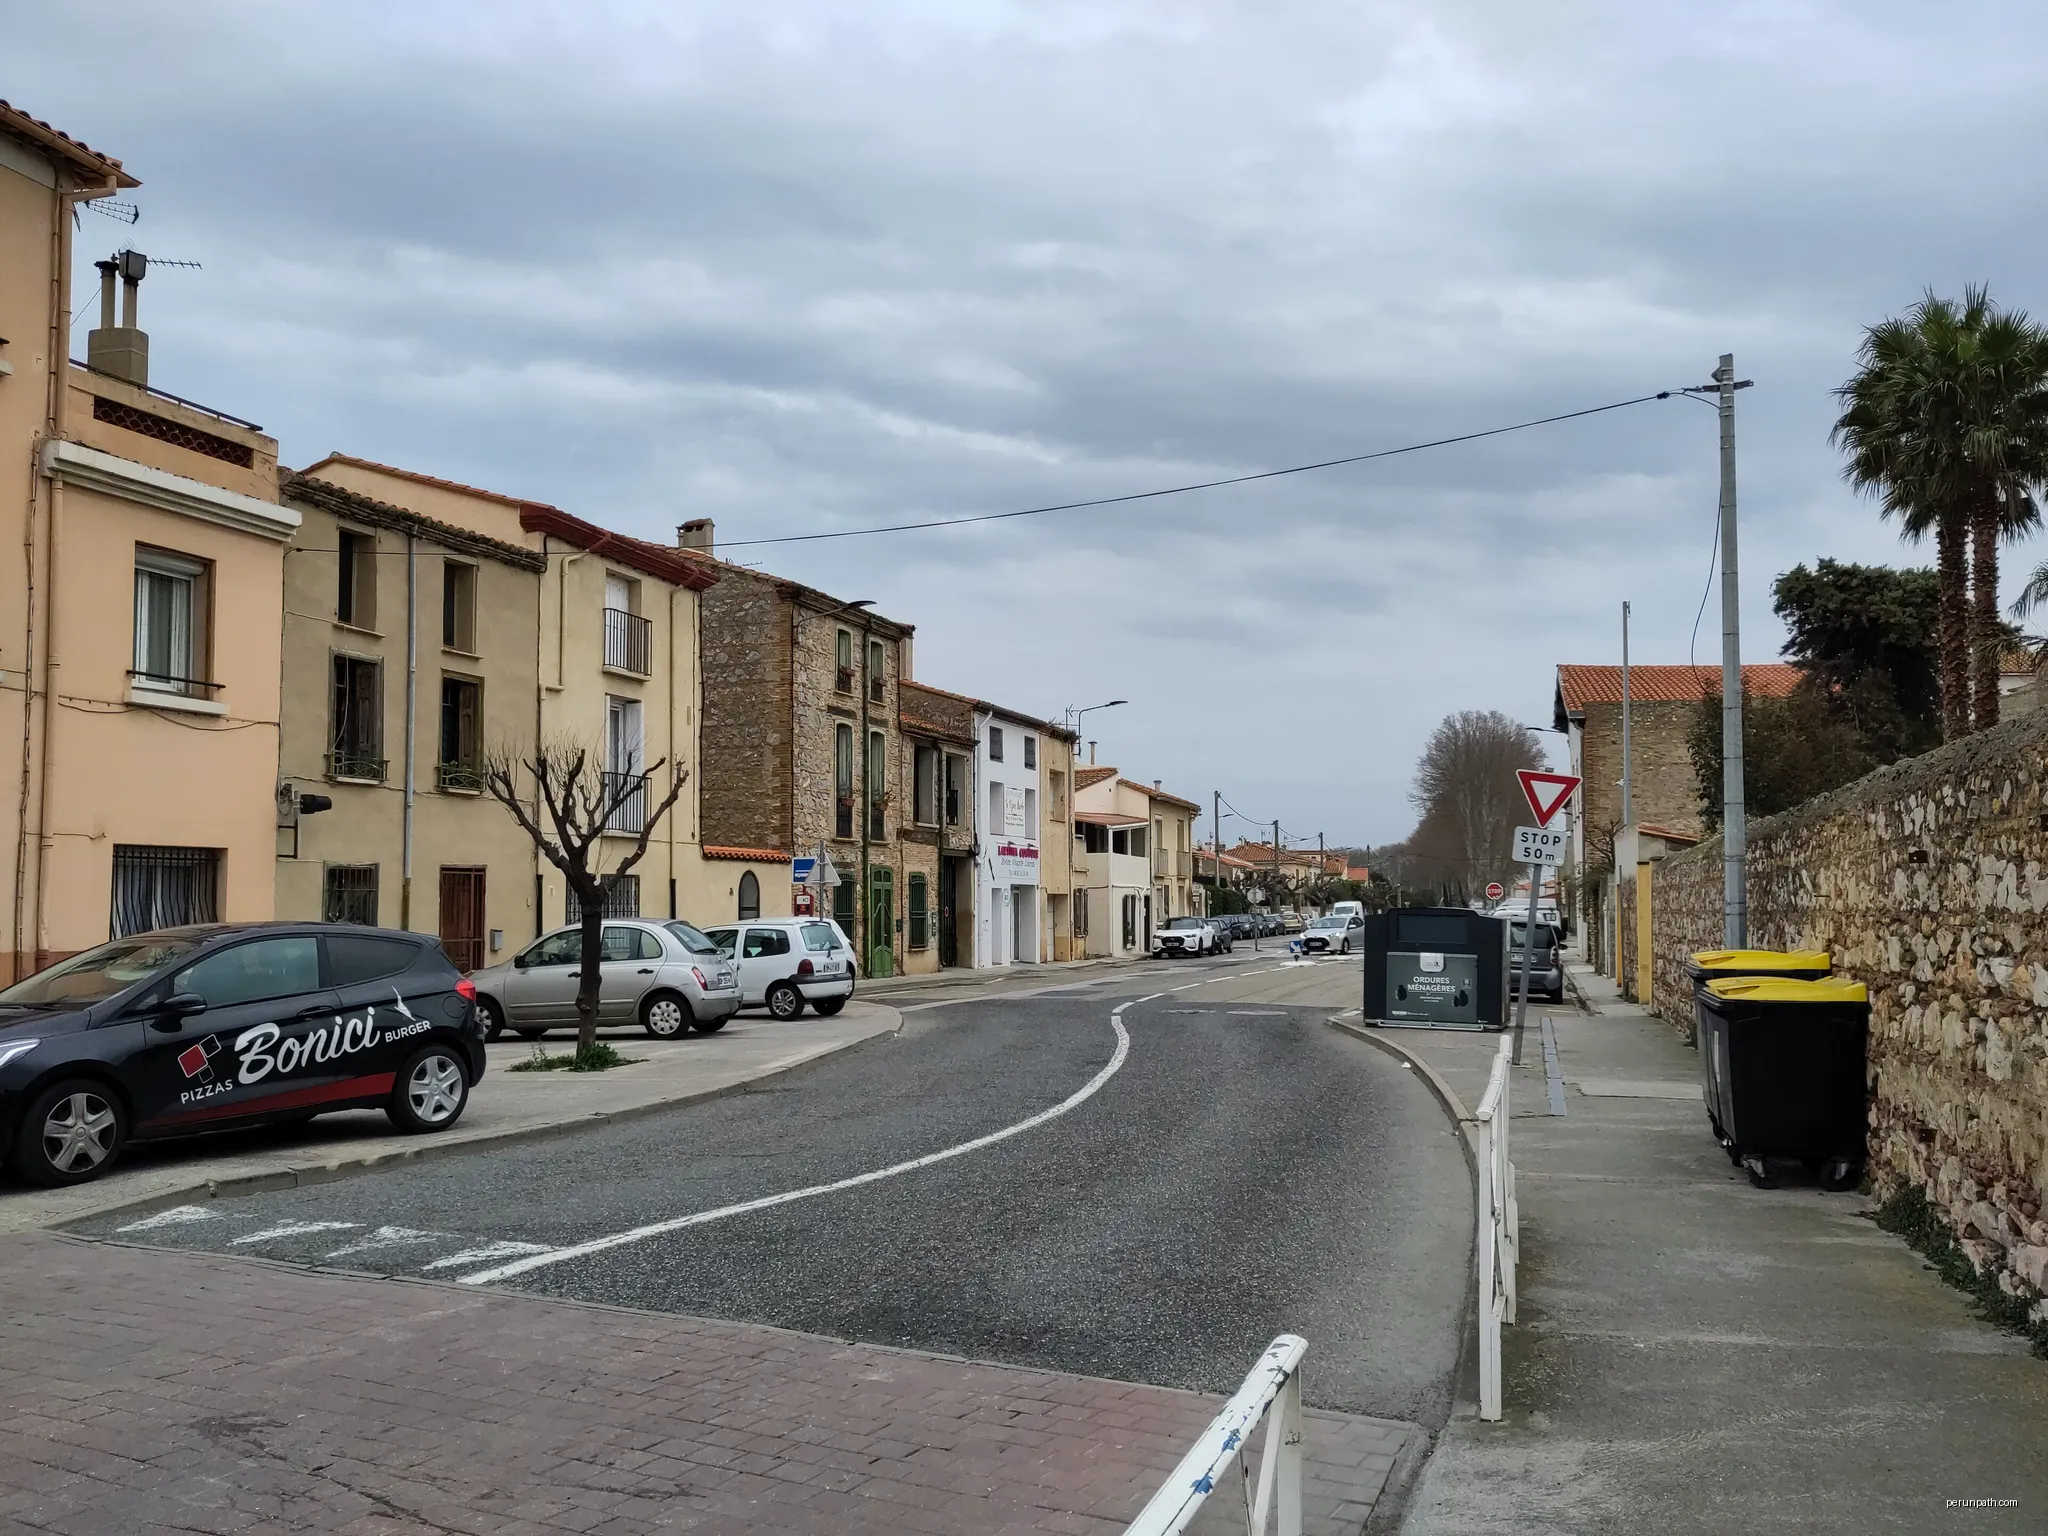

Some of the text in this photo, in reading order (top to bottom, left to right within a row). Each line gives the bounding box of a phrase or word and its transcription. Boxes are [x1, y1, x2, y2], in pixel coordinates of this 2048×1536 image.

[1521, 832, 1561, 846] STOP
[1523, 847, 1555, 861] 50 m
[1413, 976, 1450, 984] ORDURES
[1407, 983, 1456, 993] MÉNAGÈRES
[384, 1020, 432, 1043] BURGER
[234, 1006, 381, 1084] Bonici
[180, 1079, 234, 1104] PIZZAS
